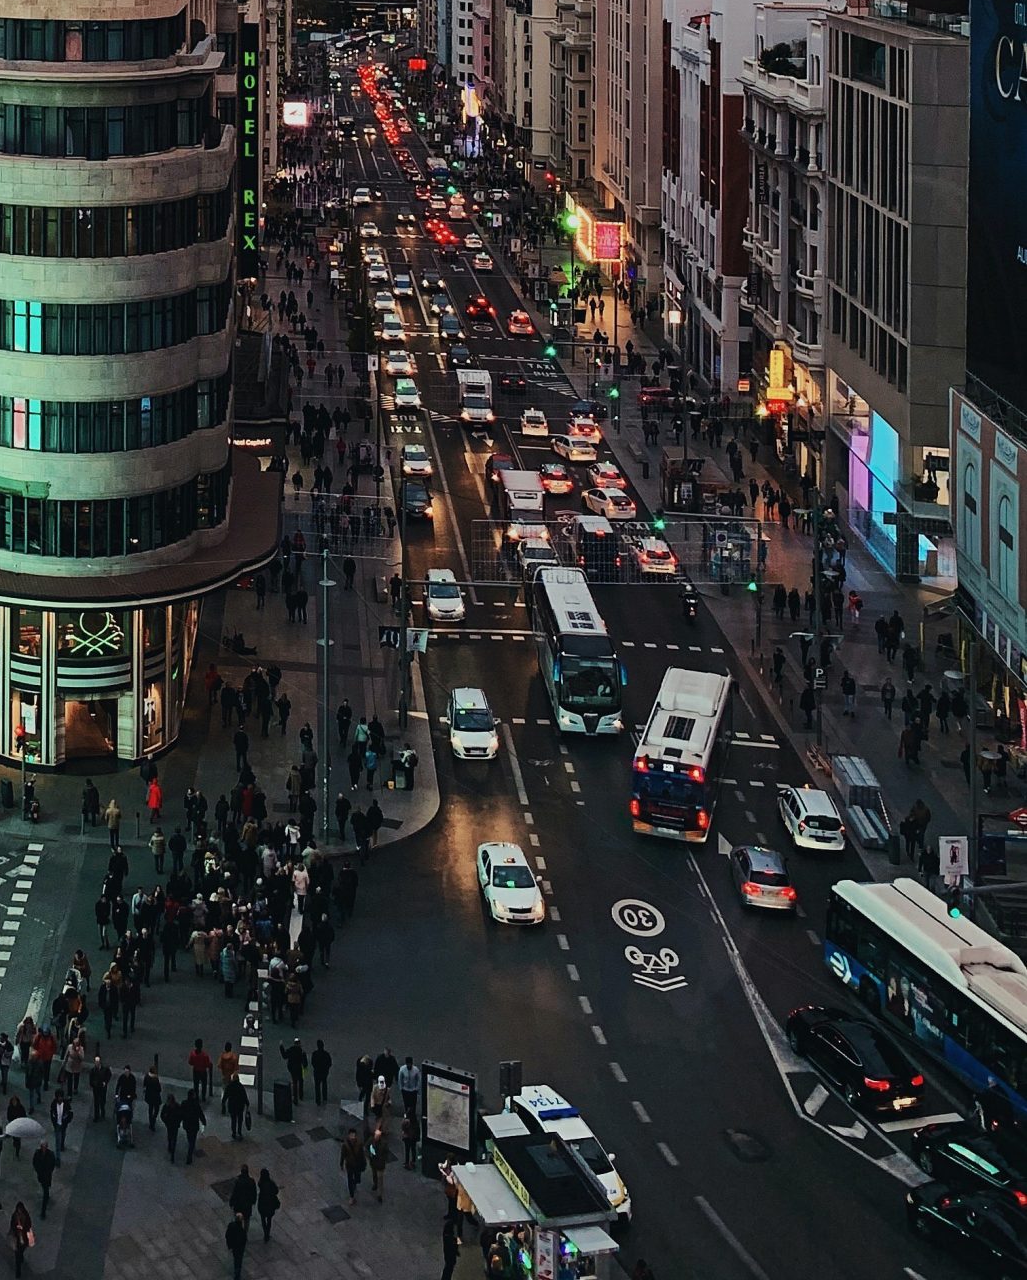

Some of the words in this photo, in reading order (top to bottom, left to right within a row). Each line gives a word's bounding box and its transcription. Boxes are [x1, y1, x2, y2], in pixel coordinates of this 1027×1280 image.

[243, 51, 256, 157] HOTEL
[243, 189, 256, 250] REX
[527, 363, 556, 371] TAXI
[389, 414, 417, 422] BUS
[390, 425, 422, 434] TAXI
[623, 908, 653, 927] 30
[528, 1097, 564, 1107] 7134
